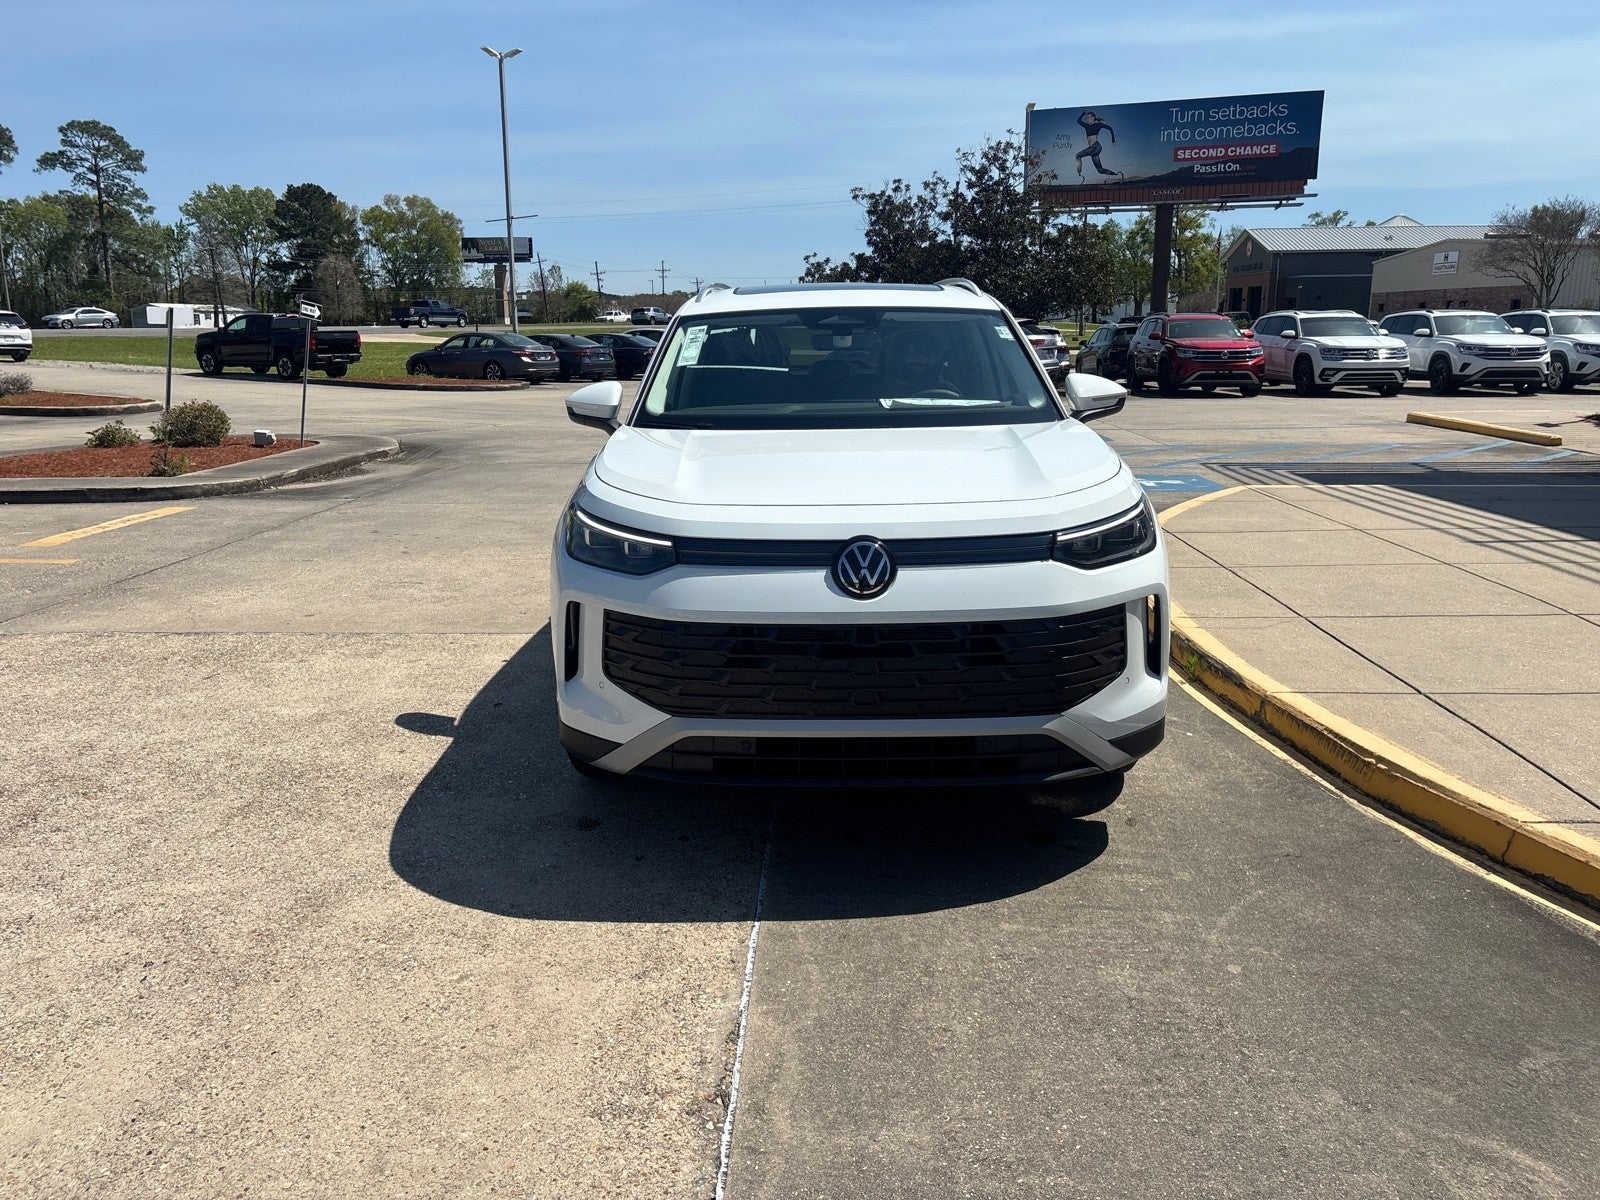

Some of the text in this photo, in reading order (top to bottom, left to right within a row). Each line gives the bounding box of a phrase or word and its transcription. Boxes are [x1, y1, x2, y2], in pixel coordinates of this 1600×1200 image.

[1169, 102, 1289, 123] Turn setbacks
[1055, 134, 1072, 143] Amy
[1160, 120, 1300, 142] into comebacks.
[1177, 144, 1277, 159] SECOND CHANCE
